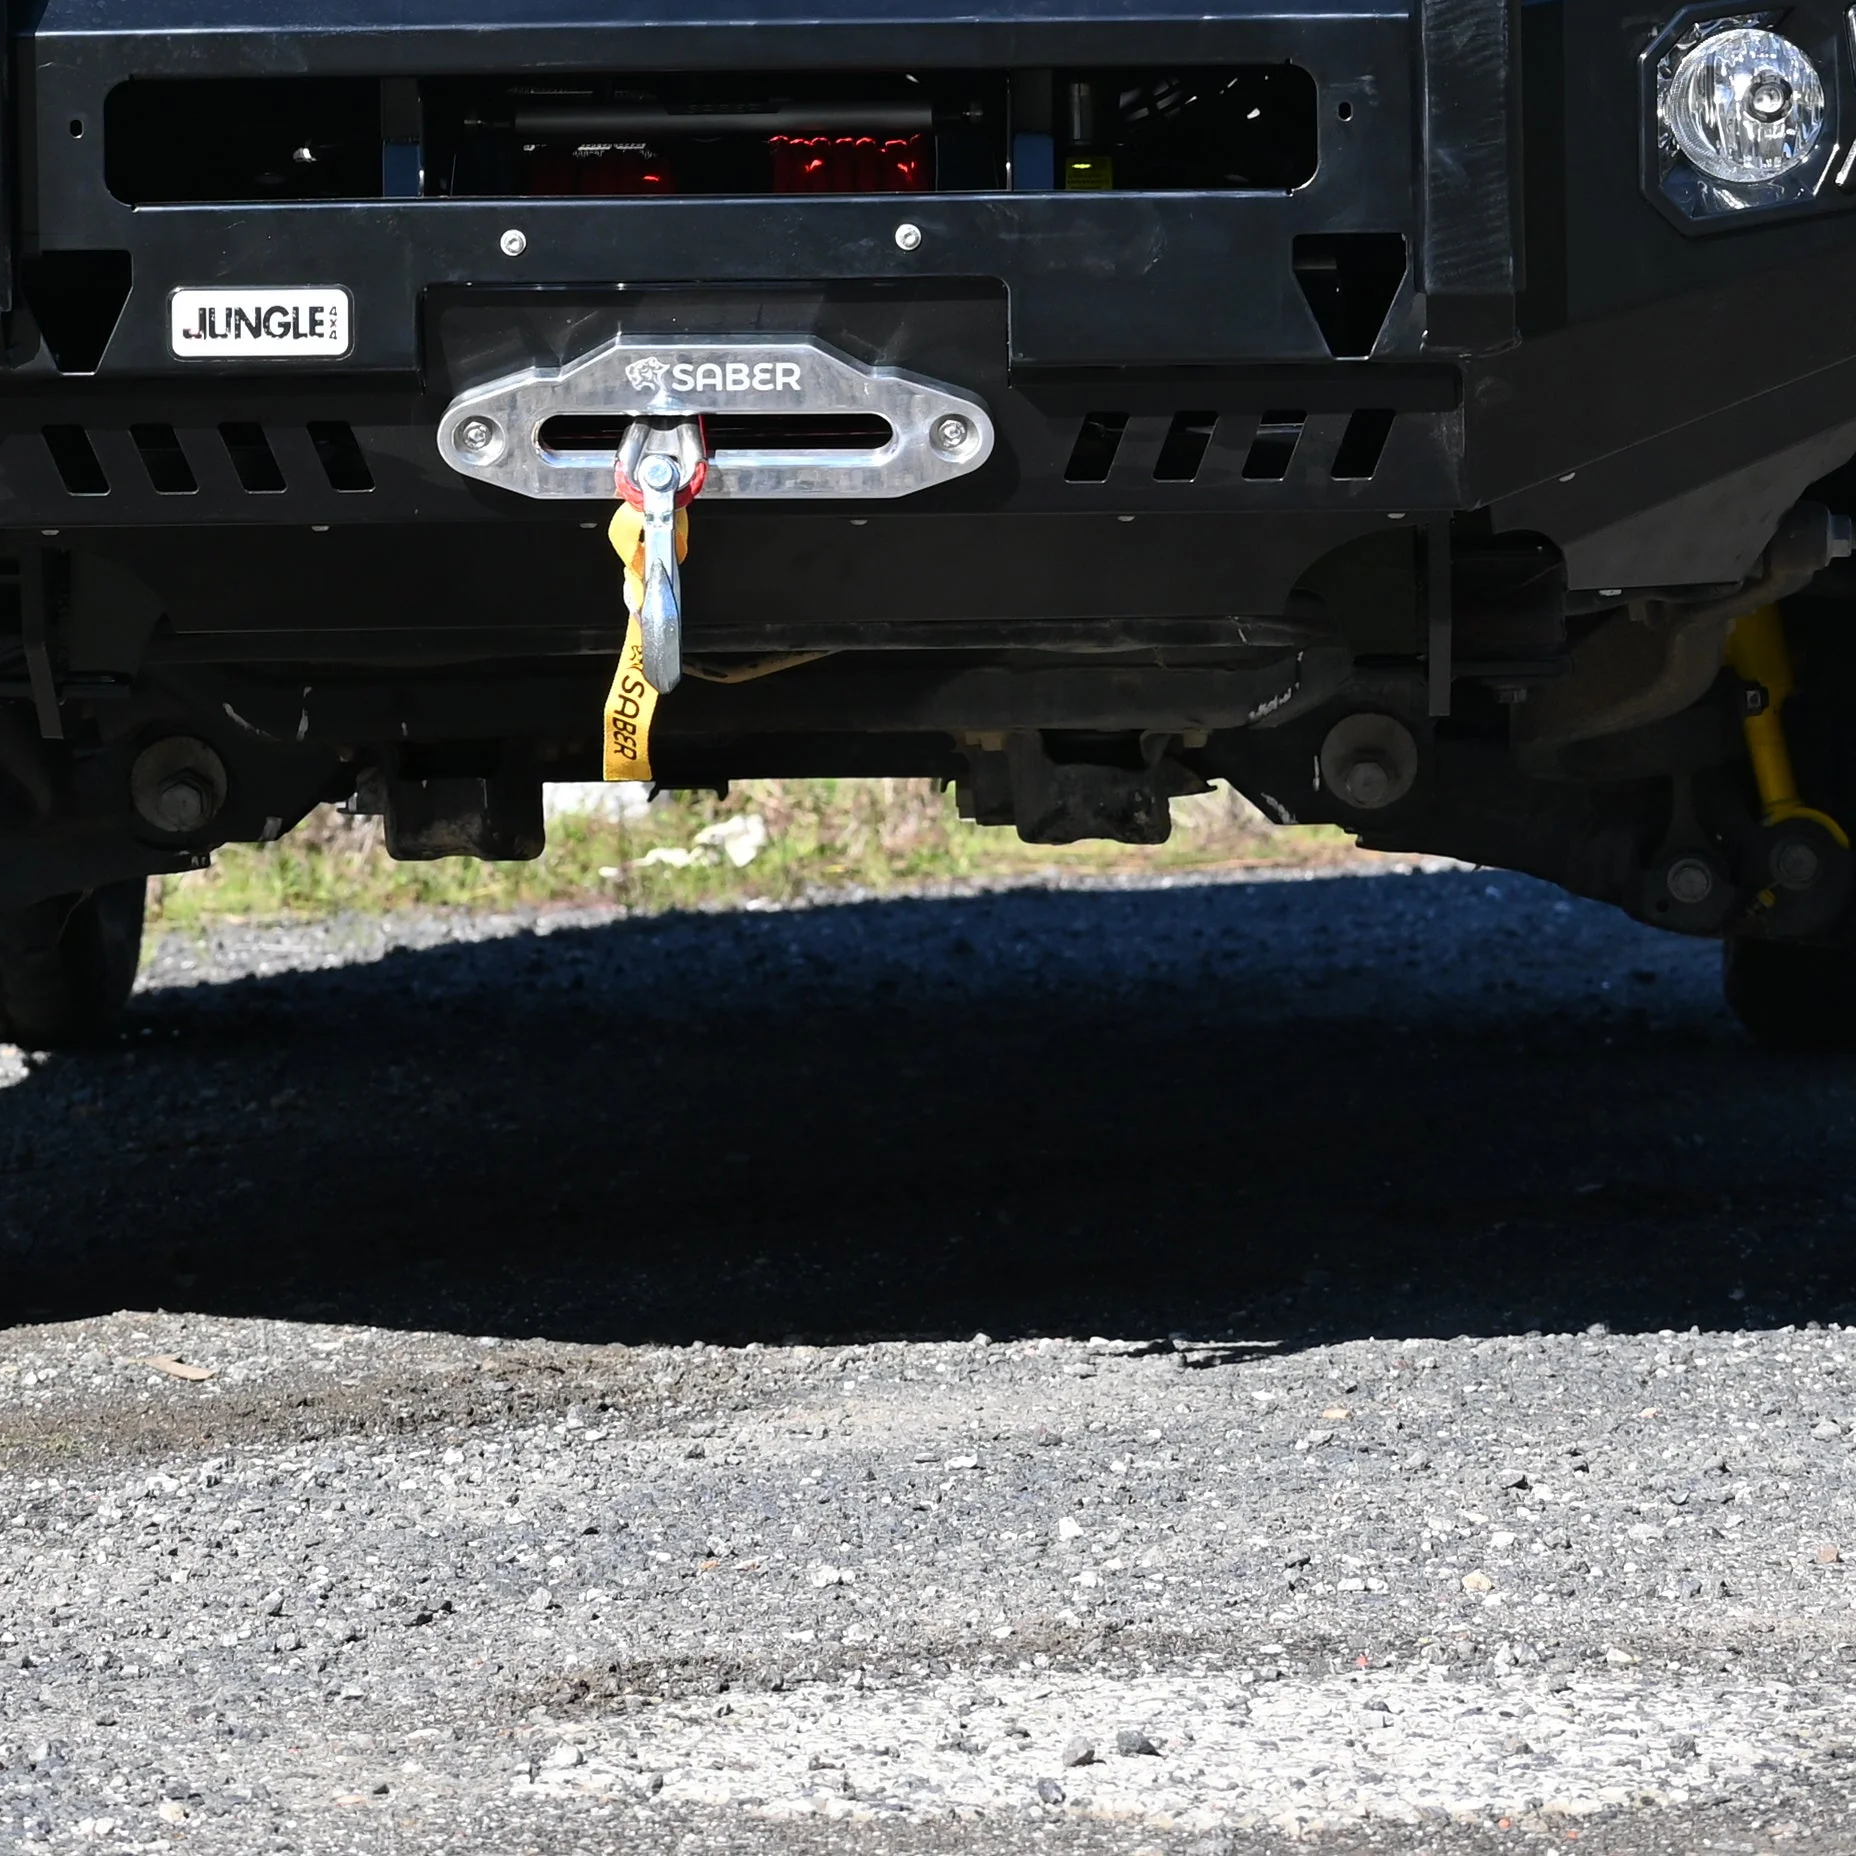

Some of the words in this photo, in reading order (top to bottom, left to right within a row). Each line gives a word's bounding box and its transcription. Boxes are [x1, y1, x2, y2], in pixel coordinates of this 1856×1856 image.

[182, 305, 325, 340] JUNGLE
[671, 362, 801, 392] SABER
[612, 674, 645, 761] SABER
